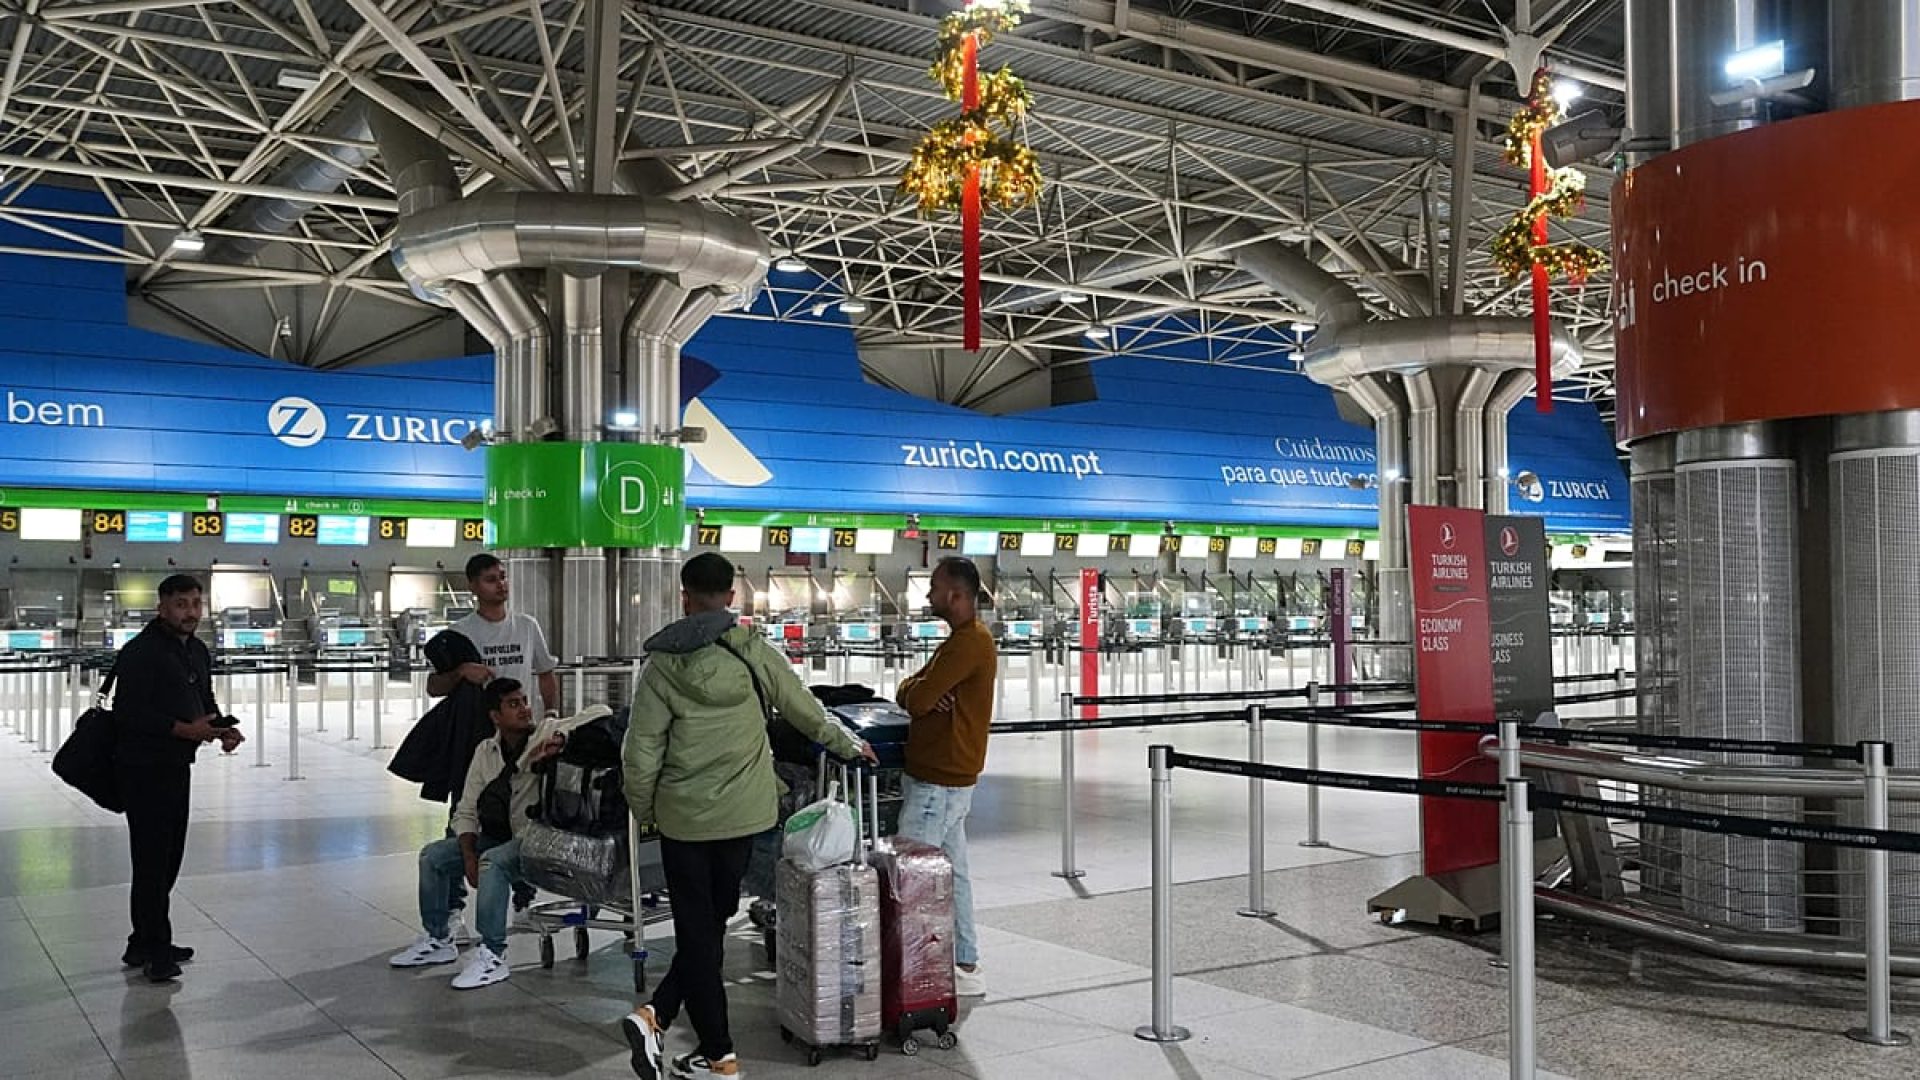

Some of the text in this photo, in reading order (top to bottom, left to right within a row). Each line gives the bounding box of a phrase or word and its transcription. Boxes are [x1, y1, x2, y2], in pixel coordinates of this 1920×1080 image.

[1653, 256, 1766, 302] check in
[8, 391, 104, 427] bem
[1274, 437, 1376, 463] Cuidamos
[901, 440, 1104, 480] zurich.com.pt
[1221, 464, 1266, 486] para
[1270, 468, 1308, 488] que
[504, 484, 547, 500] check in
[620, 476, 646, 514] D
[1549, 480, 1610, 500] ZURICH
[0, 511, 17, 531] 5
[95, 513, 124, 533] 84
[193, 516, 222, 535] 83
[290, 518, 316, 537] 82
[380, 521, 406, 538] 81
[699, 529, 719, 545] 77
[769, 529, 789, 545] 76
[835, 531, 854, 546] 75
[938, 533, 957, 548] 74
[1001, 534, 1019, 549] 73
[1057, 535, 1074, 550] 72
[1111, 536, 1127, 550] 71
[1164, 537, 1179, 551] 70
[1432, 553, 1468, 566] TURKISH
[1491, 561, 1532, 575] TURKISH
[1432, 567, 1468, 580] AIRLINES
[1491, 575, 1534, 589] AIRLINES
[1087, 586, 1099, 625] Turista
[1420, 617, 1462, 634] ECONOMY
[1421, 635, 1449, 652] CLASS
